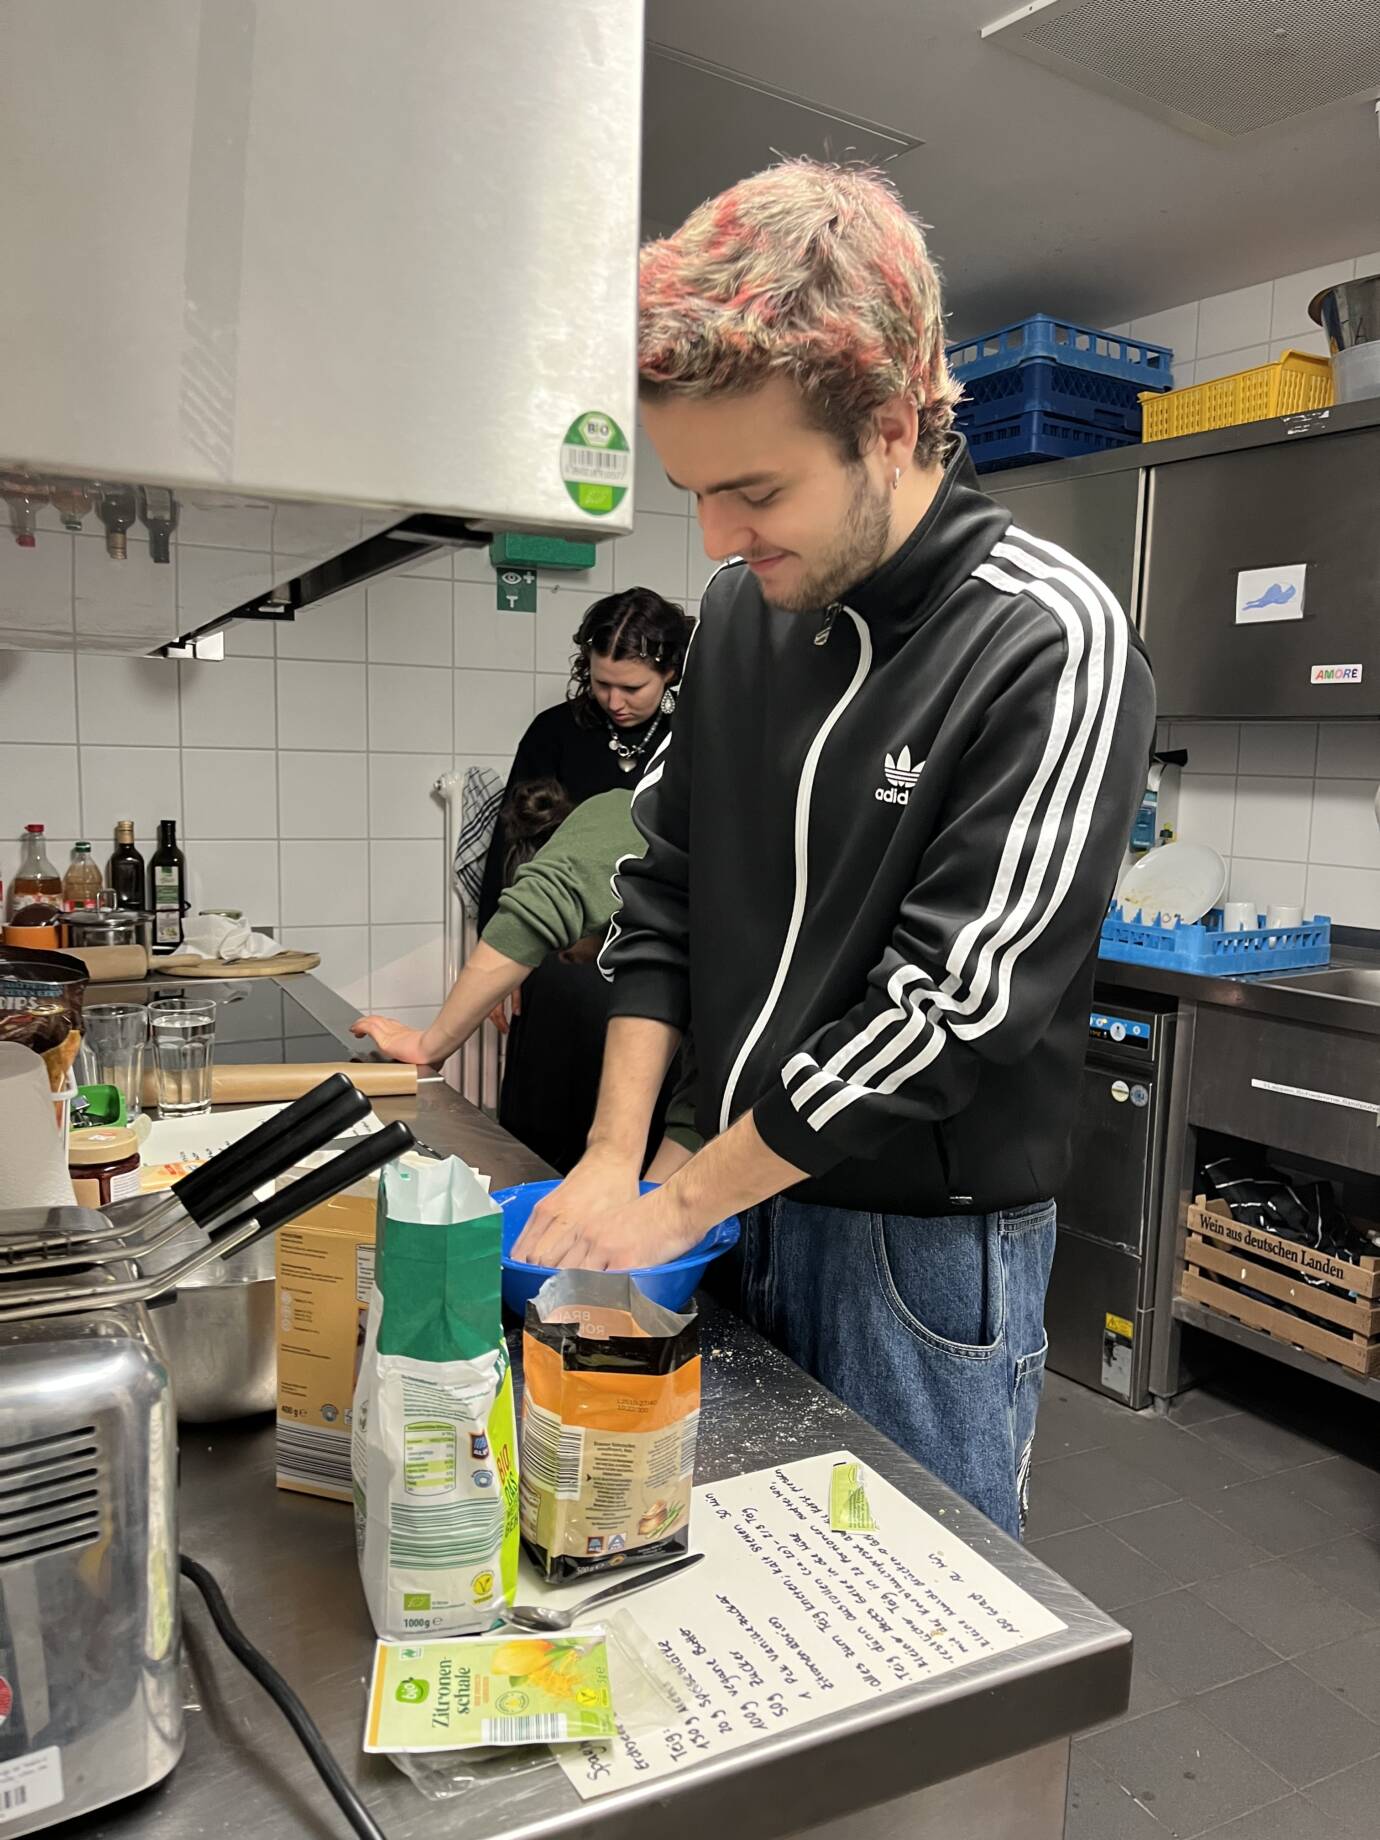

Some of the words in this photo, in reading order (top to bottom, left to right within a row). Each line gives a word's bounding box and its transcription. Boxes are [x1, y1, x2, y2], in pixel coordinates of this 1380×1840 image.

[587, 422, 610, 436] BIO
[1315, 667, 1359, 681] AMORE
[874, 787, 909, 806] adid
[1199, 1213, 1226, 1236] Wein
[1226, 1226, 1243, 1244] aus
[1244, 1230, 1299, 1263] deutschen
[1300, 1250, 1345, 1280] Landen
[741, 1507, 759, 1525] Teig
[879, 1591, 901, 1615] Teig
[403, 1617, 431, 1629] 1000g
[811, 1610, 833, 1634] Teig
[885, 1655, 911, 1681] Teig
[401, 1682, 419, 1700] bio
[431, 1656, 453, 1728] Zitronen-
[452, 1666, 472, 1715] schale
